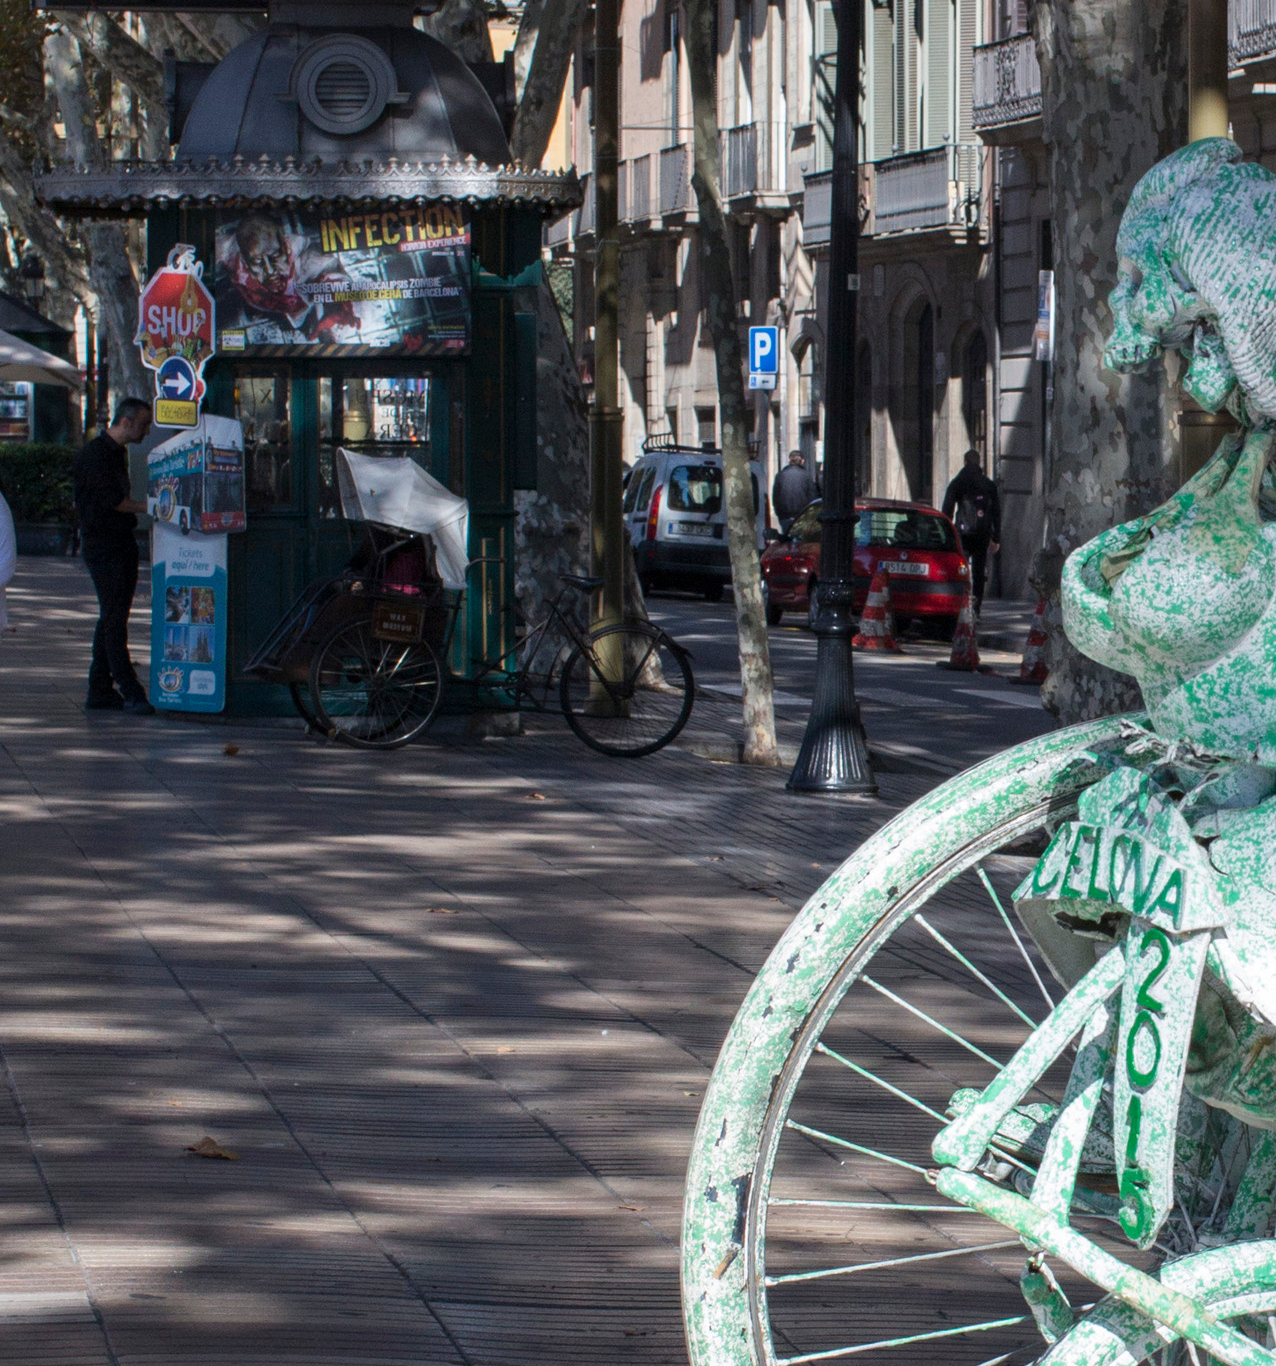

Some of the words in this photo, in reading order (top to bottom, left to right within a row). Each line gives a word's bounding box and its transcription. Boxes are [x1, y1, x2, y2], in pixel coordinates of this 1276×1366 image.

[320, 205, 465, 253] INFECTION
[401, 240, 427, 252] HORROR
[427, 235, 467, 250] EXPERIENCE
[366, 290, 378, 300] DE
[378, 289, 402, 300] CERA
[402, 289, 413, 299] DE
[409, 276, 442, 289] ZOMBIE
[148, 305, 206, 336] SHOP
[754, 331, 772, 368] P
[1119, 928, 1171, 1240] 2015
